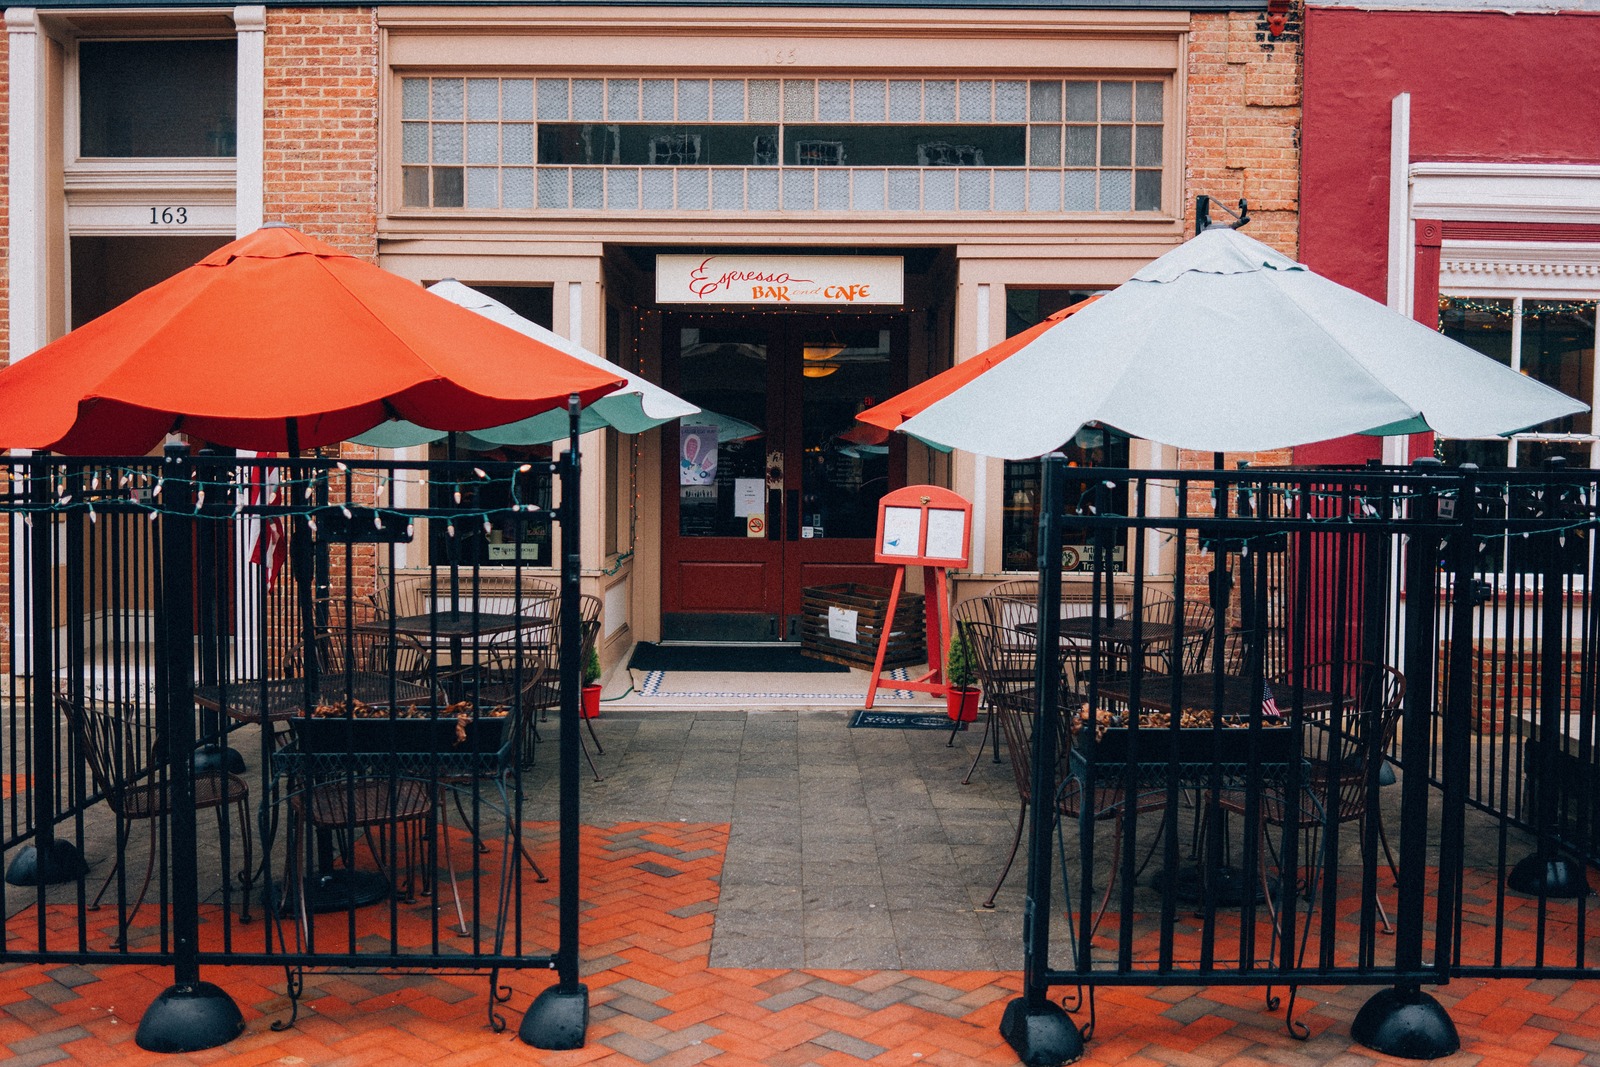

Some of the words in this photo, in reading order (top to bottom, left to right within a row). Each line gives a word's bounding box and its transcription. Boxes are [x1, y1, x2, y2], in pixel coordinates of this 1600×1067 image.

[150, 206, 188, 225] 163
[688, 255, 815, 299] Espresso
[752, 285, 791, 302] BAR
[792, 286, 822, 296] and
[823, 284, 871, 301] CAFE
